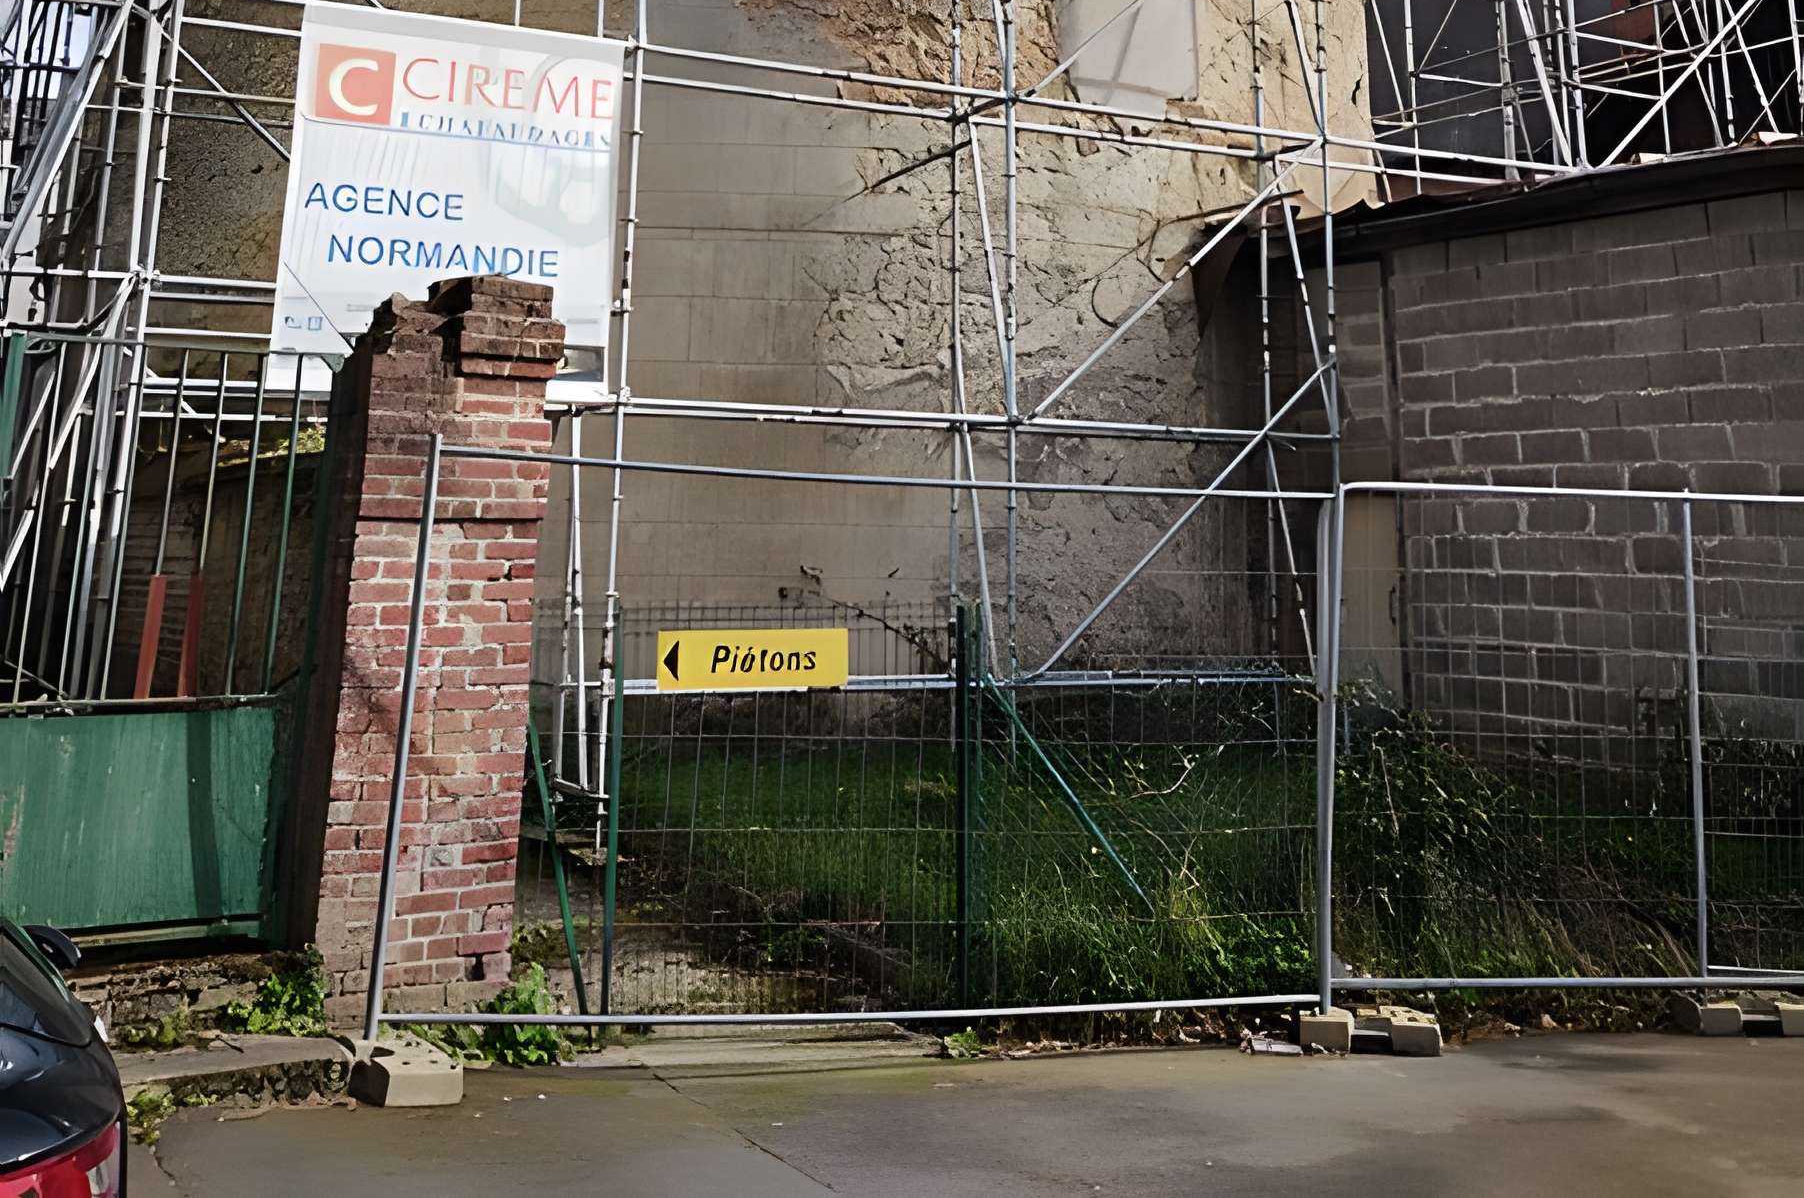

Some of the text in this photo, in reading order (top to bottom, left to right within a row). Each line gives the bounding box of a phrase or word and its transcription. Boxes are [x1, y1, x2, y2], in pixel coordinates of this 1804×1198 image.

[402, 57, 613, 120] CIREME
[304, 182, 464, 221] AGENCE
[327, 234, 559, 278] NORMANDIE
